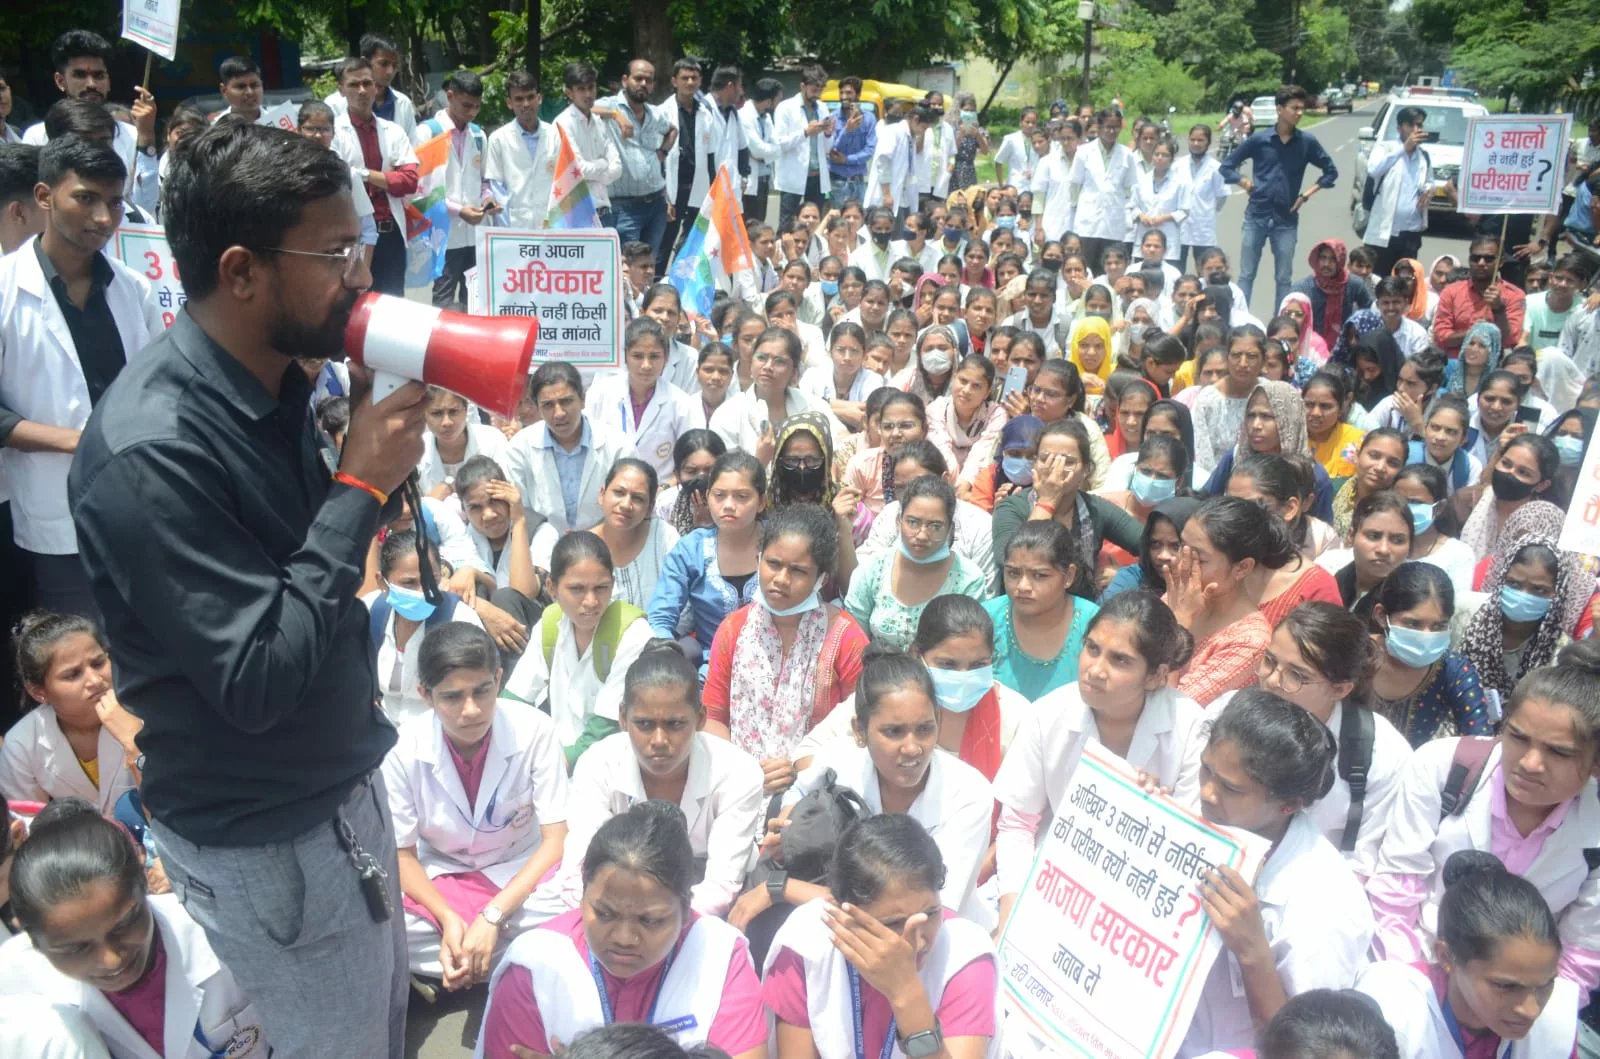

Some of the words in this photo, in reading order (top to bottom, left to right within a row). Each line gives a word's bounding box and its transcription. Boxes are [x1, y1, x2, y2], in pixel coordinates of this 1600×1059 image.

[1483, 131, 1495, 149] 3
[1500, 124, 1549, 149] सालों
[1488, 152, 1497, 165] से
[1520, 152, 1536, 168] हुई
[1471, 167, 1531, 192] परीक्षाएं
[519, 244, 540, 258] हम
[545, 244, 584, 259] अपना
[143, 251, 164, 280] 3
[502, 260, 604, 295] अधिकार
[158, 286, 172, 308] से
[542, 302, 568, 320] नहीं
[572, 302, 608, 321] किसी
[562, 323, 601, 341] मांगते
[1069, 783, 1109, 822] आखिर
[1105, 807, 1117, 828] 3
[1115, 811, 1152, 848] सालों
[1147, 826, 1167, 858] से
[1053, 816, 1075, 845] की
[1070, 822, 1104, 867] परीक्षा
[1102, 848, 1131, 882] क्यों
[1125, 868, 1159, 902] नहीं
[1151, 884, 1184, 918] हुई
[1035, 859, 1096, 931] भाजपा
[1090, 902, 1179, 987] सरकार
[1052, 943, 1086, 984] जवाब
[1083, 963, 1102, 997] दो
[1010, 963, 1029, 983] रवि
[1024, 975, 1054, 1008] परमार
